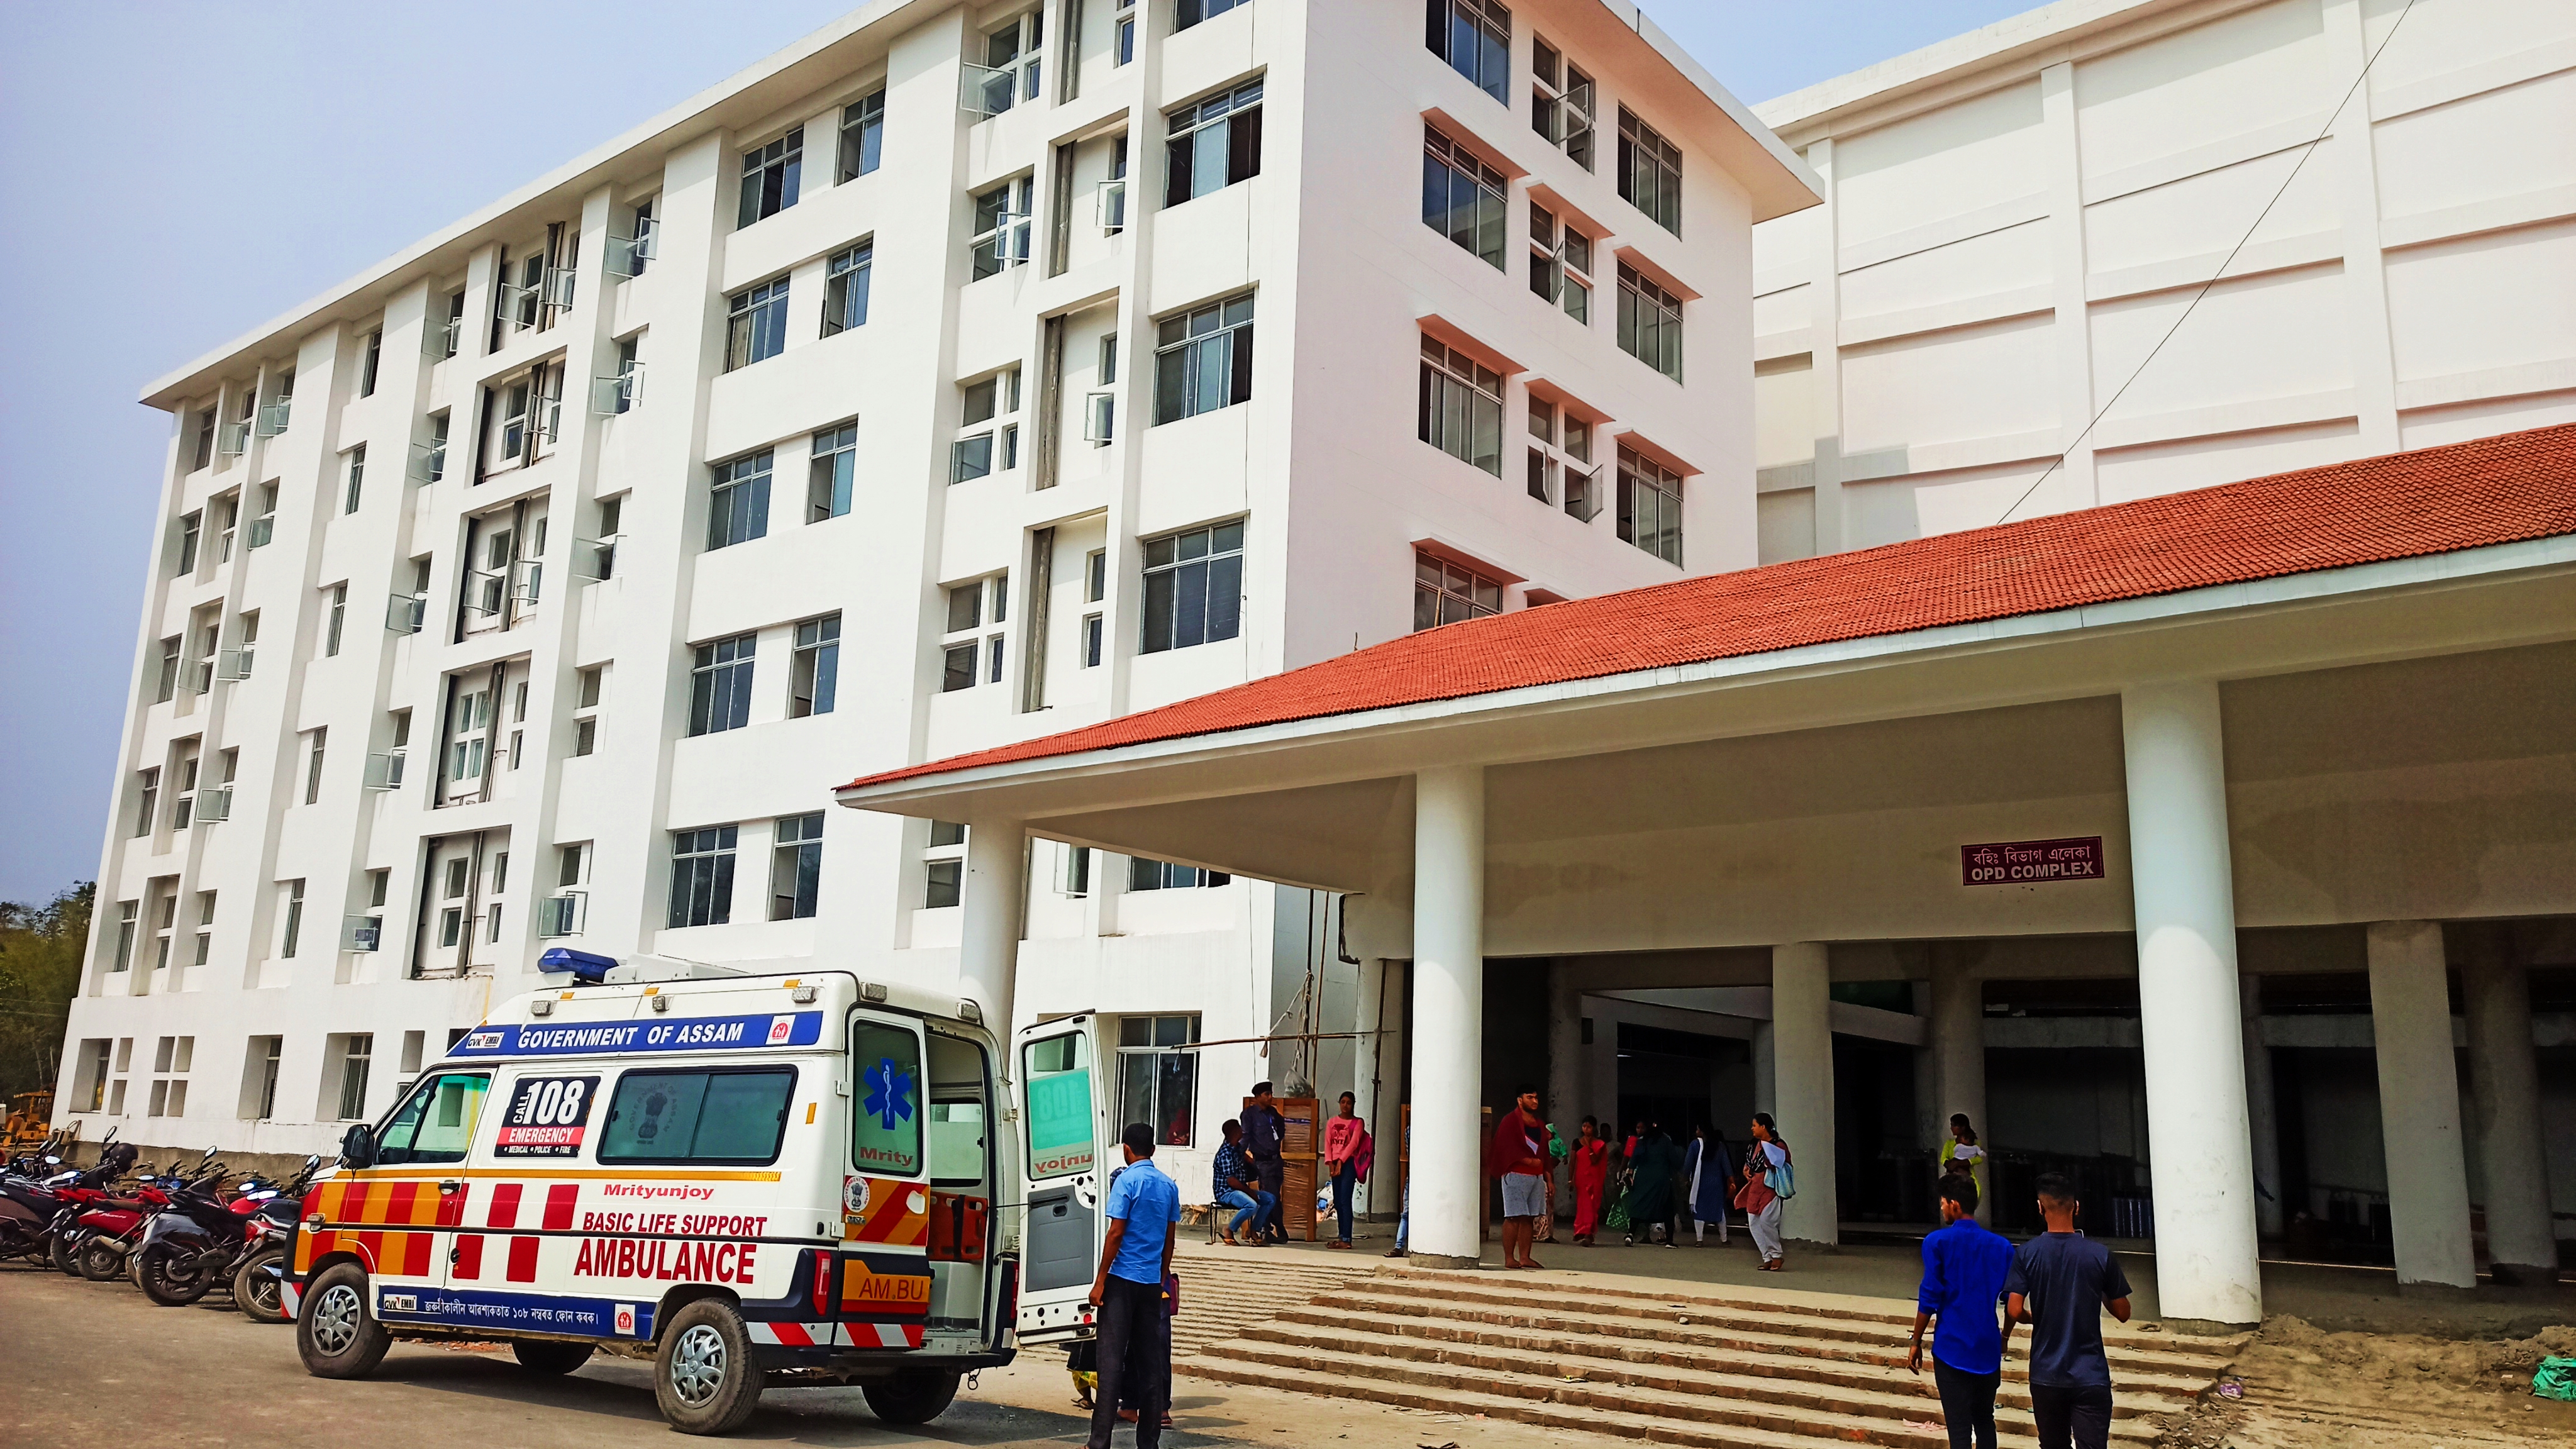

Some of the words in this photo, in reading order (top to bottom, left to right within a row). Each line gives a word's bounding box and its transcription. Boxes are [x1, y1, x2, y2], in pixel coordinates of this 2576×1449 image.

[1972, 848, 1998, 865] বহিঃ
[2004, 847, 2042, 863] বিভাগ
[2048, 845, 2090, 860] এলেকা
[1972, 867, 2006, 880] OPD
[2011, 861, 2094, 879] COMPLEX
[468, 1038, 482, 1046] GVK
[518, 1027, 639, 1048] GOVERNMENT
[647, 1026, 674, 1045] OF
[675, 1023, 745, 1043] ASSAM
[513, 1093, 530, 1123] CALL
[522, 1080, 585, 1124] 108
[508, 1128, 574, 1143] EMERGENCY
[508, 1145, 528, 1153] MEDICAL
[534, 1145, 552, 1153] POLICE
[559, 1145, 571, 1153] FIRE
[860, 1146, 913, 1167] Mrity
[604, 1184, 714, 1200] Mrityunjoy
[583, 1212, 634, 1232] BASIC
[638, 1214, 677, 1234] LIFE
[681, 1214, 767, 1236] SUPPORT
[574, 1238, 757, 1284] AMBULANCE
[384, 1300, 397, 1309] GVK
[401, 1299, 414, 1309] EMRI
[513, 1307, 528, 1319] ১০৮
